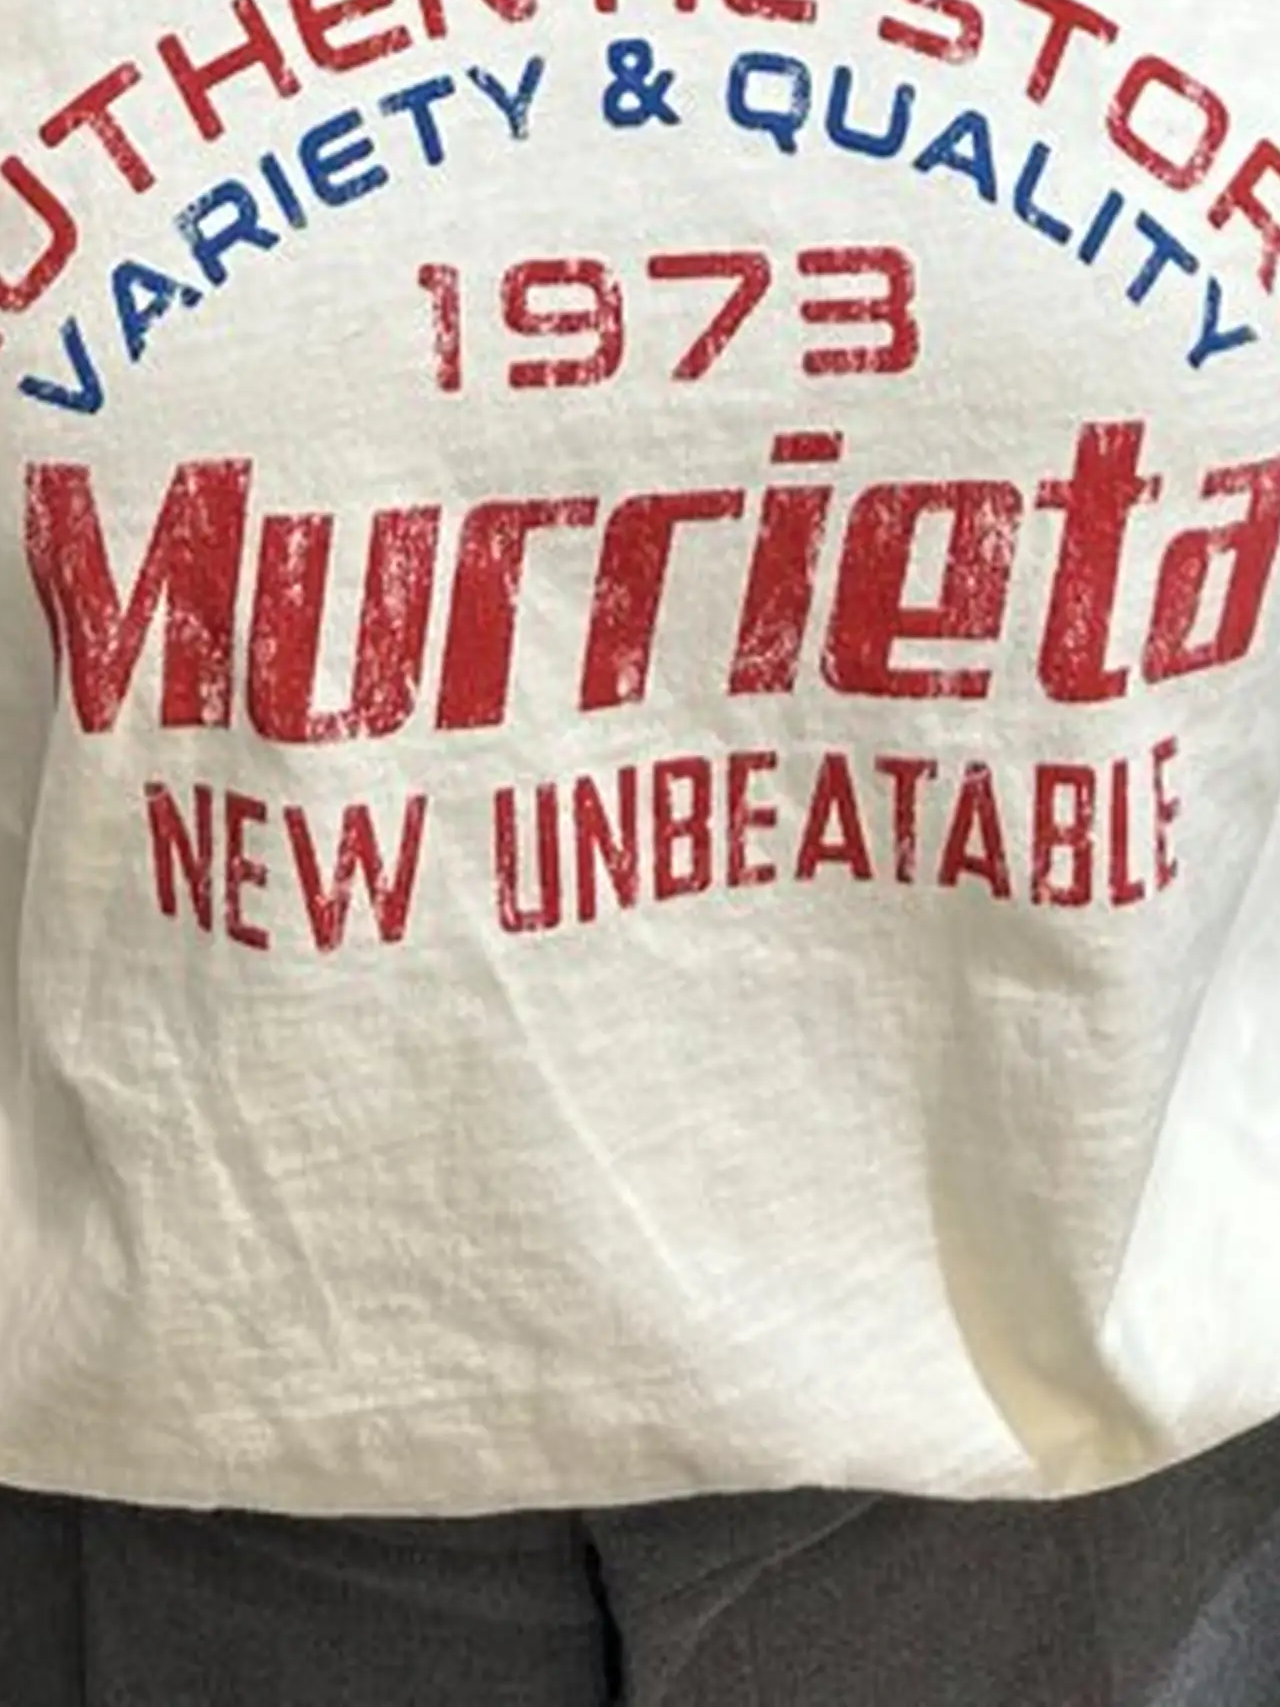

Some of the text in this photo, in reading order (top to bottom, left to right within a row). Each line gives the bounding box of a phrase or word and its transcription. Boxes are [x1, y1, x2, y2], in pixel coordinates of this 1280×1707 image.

[21, 38, 1260, 415] VARIETY & QUALITY
[418, 245, 920, 390] 1973
[145, 737, 1181, 951] NEW UNBEATABLE
